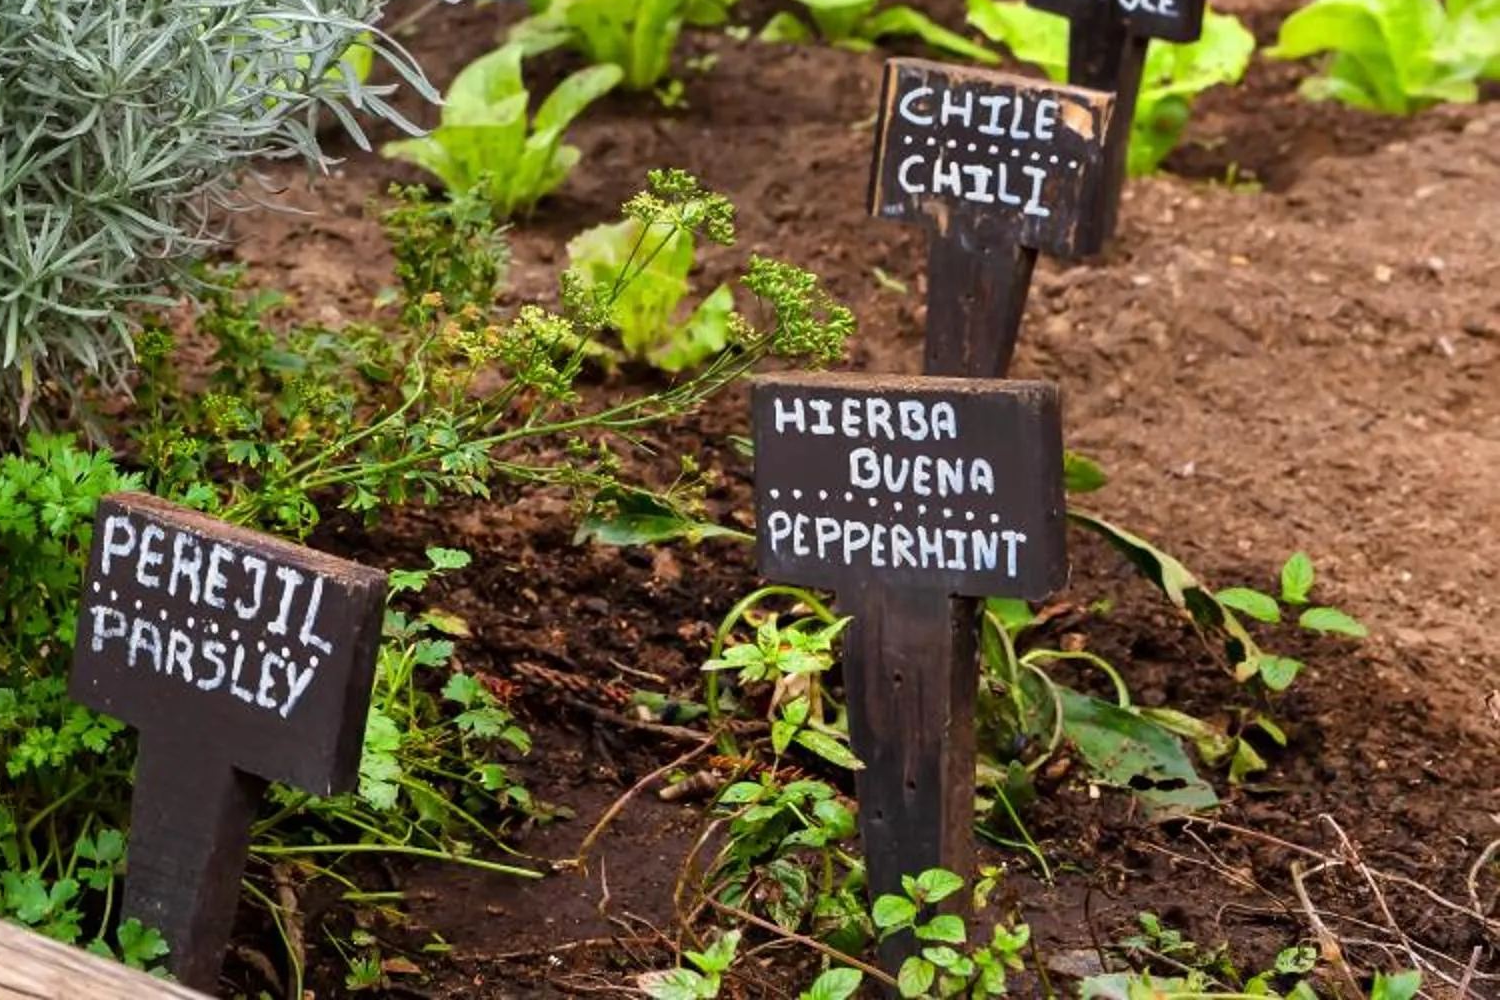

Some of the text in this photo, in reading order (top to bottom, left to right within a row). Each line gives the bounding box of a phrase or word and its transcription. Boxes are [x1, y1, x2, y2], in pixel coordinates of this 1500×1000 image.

[900, 87, 1060, 140] CHILE
[898, 154, 1050, 217] CHILI
[774, 397, 957, 441] HIERBA
[850, 447, 995, 498] BUENA
[767, 510, 1027, 578] PEPPERMINT
[89, 604, 315, 719] PARSLEY
